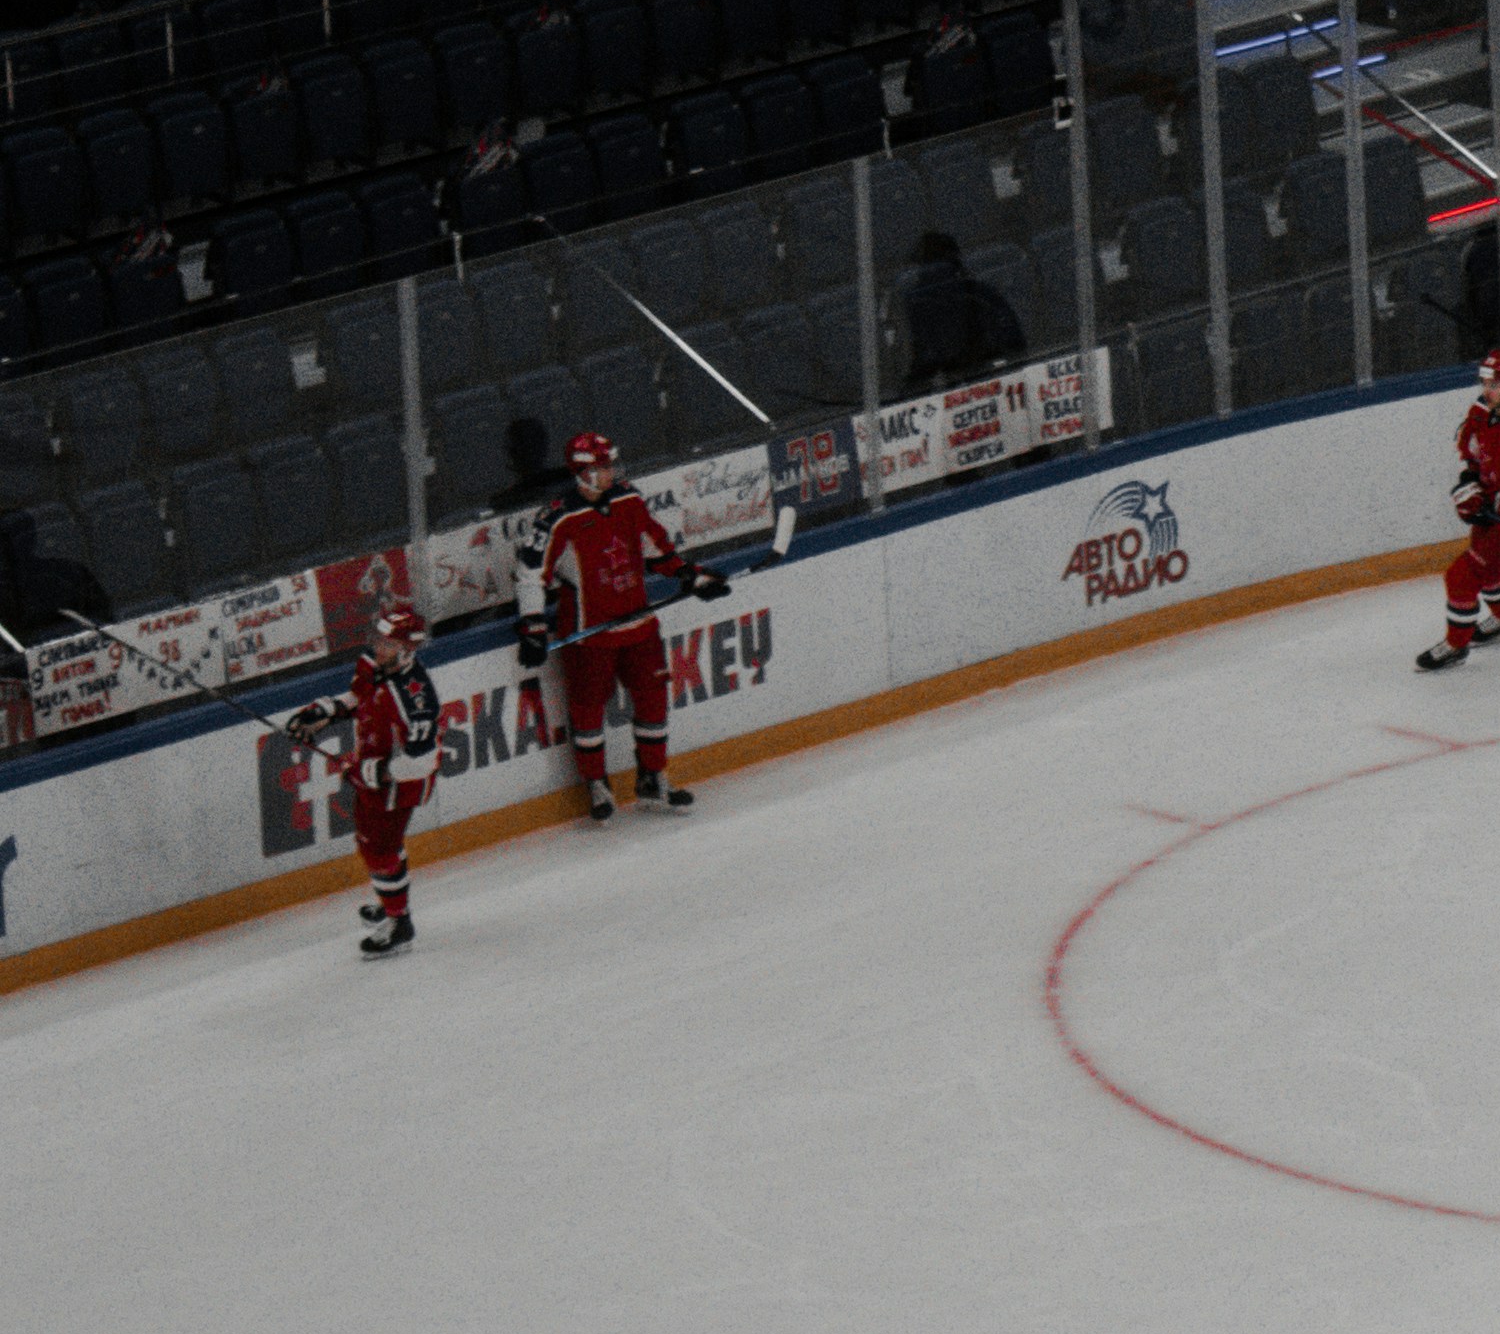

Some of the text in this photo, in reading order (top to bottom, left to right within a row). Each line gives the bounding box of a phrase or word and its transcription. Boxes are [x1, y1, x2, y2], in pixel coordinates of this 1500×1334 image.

[952, 382, 1027, 430] СЕРГЕЙ 11
[1061, 527, 1143, 581] АВТО
[1085, 549, 1189, 607] РАДИО
[108, 641, 123, 670] 9
